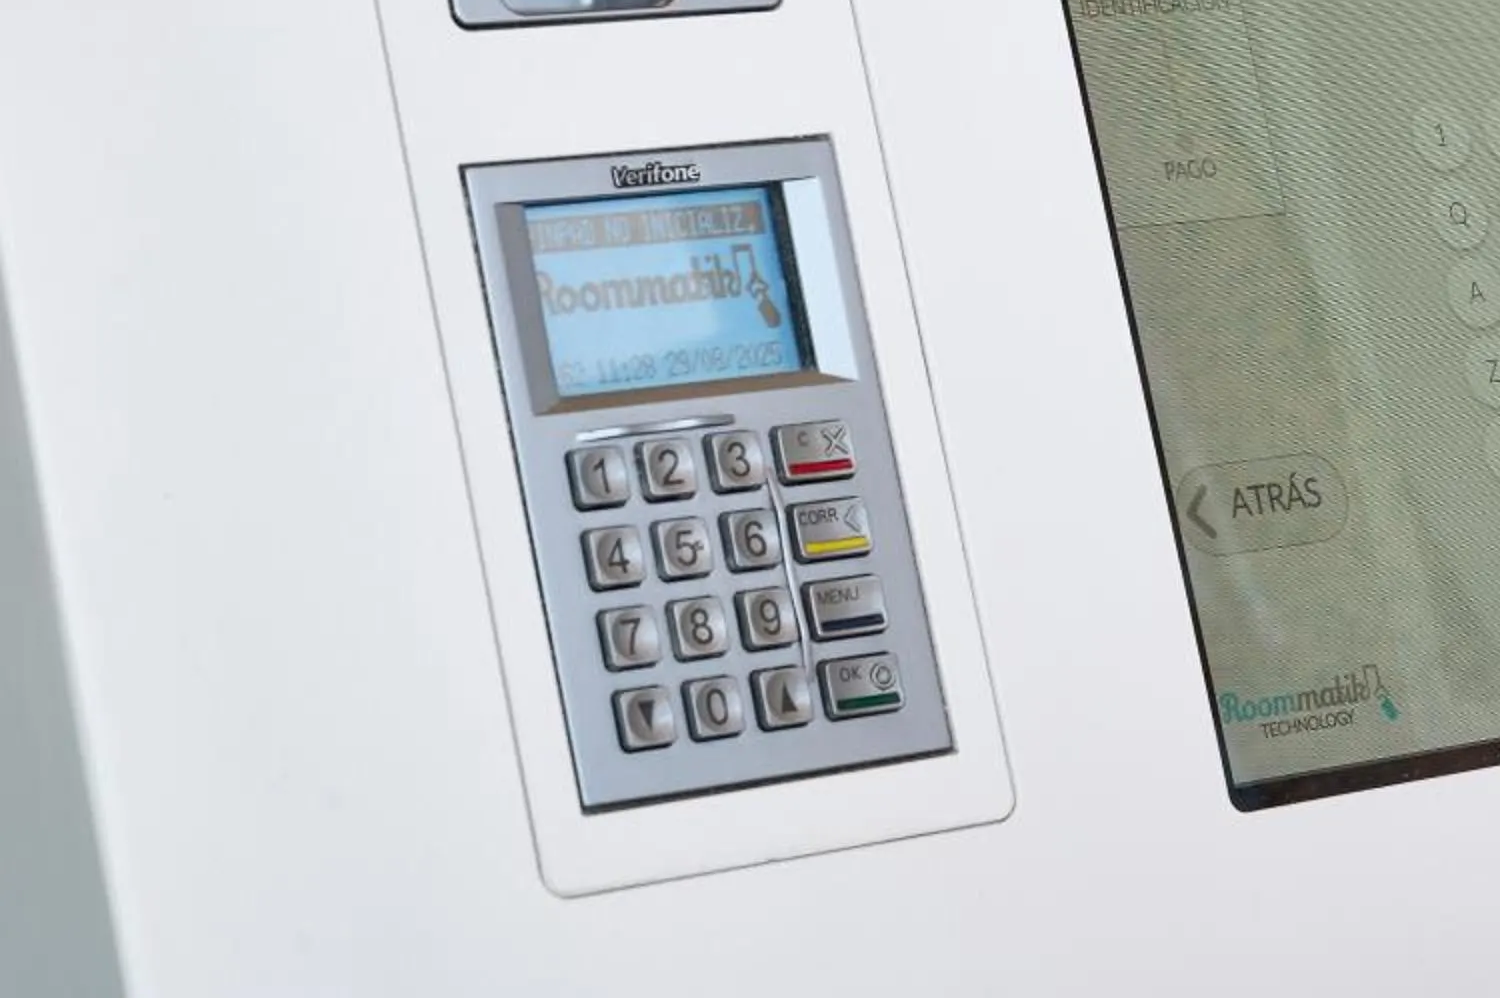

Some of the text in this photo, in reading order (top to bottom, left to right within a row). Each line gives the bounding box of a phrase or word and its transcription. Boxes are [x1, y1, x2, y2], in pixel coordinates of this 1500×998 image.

[1433, 122, 1447, 148] 1
[610, 161, 701, 189] Verifone
[1164, 157, 1218, 183] PAGO
[1448, 201, 1471, 228] Q
[1470, 280, 1487, 303] A
[592, 457, 612, 495] 1
[657, 448, 685, 487] 2
[726, 440, 752, 478] 3
[1231, 472, 1323, 519] ATRÁS
[606, 507, 839, 575] 4 5 6 CORR
[618, 585, 860, 657] 7 8 9 MENU
[705, 666, 863, 727] 0 OK
[1218, 670, 1374, 726] Roommatik
[1260, 708, 1356, 740] TECHNOLOGY
